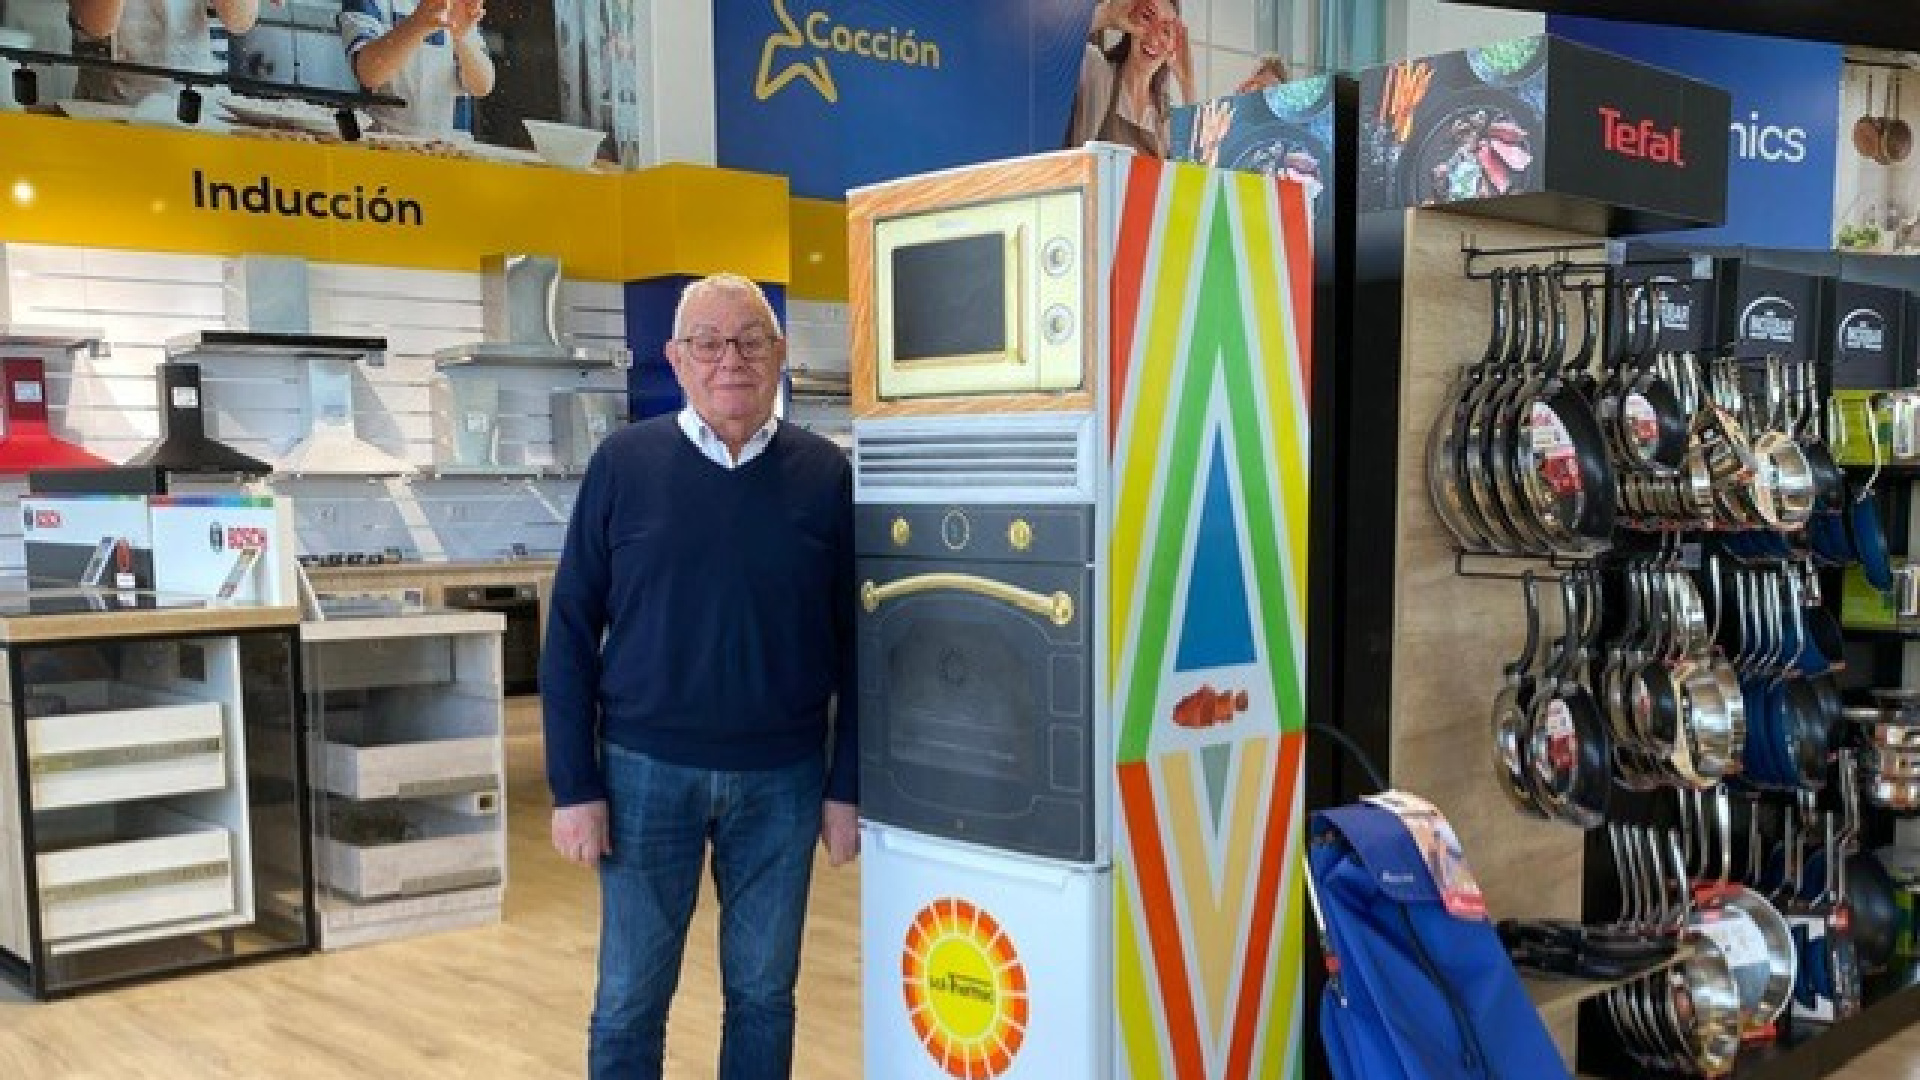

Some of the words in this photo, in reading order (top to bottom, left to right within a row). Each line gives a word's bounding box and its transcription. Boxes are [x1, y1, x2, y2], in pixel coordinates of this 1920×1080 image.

[806, 11, 940, 69] Cocción
[1598, 106, 1686, 168] Tefal
[192, 169, 423, 226] Inducción
